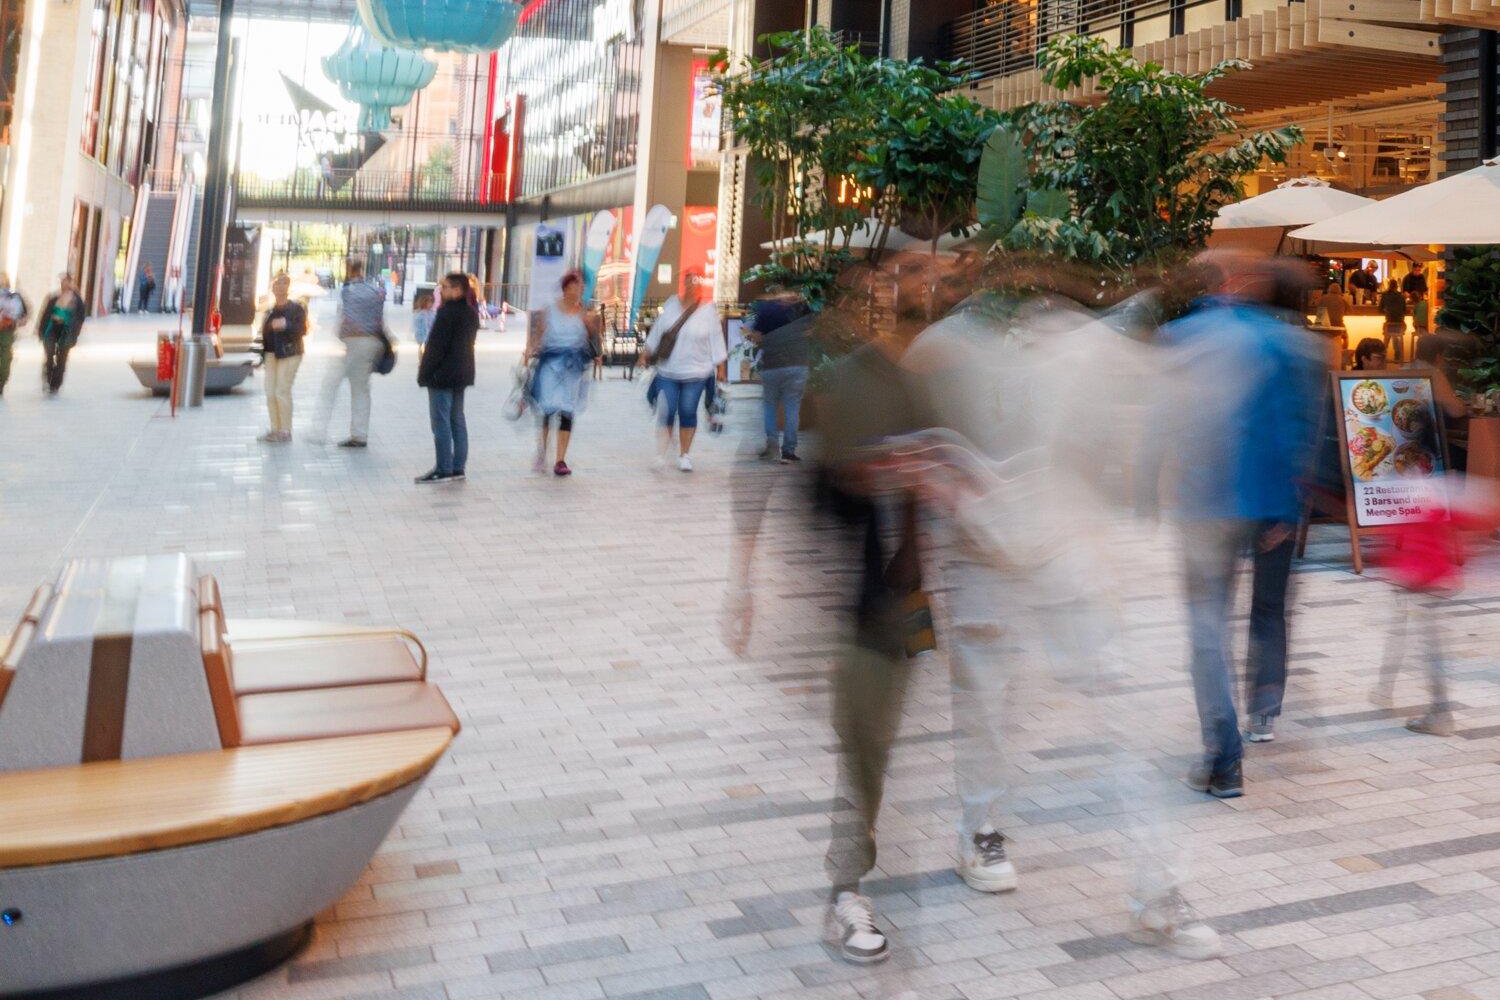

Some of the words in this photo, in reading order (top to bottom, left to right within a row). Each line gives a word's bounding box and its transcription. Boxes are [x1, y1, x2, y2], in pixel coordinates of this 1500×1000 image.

[1363, 486, 1375, 495] 22
[1364, 498, 1371, 506] 3
[1372, 497, 1392, 506] Bars
[1393, 496, 1411, 505] und
[1366, 508, 1397, 517] Menge
[1398, 506, 1422, 516] Spaß
